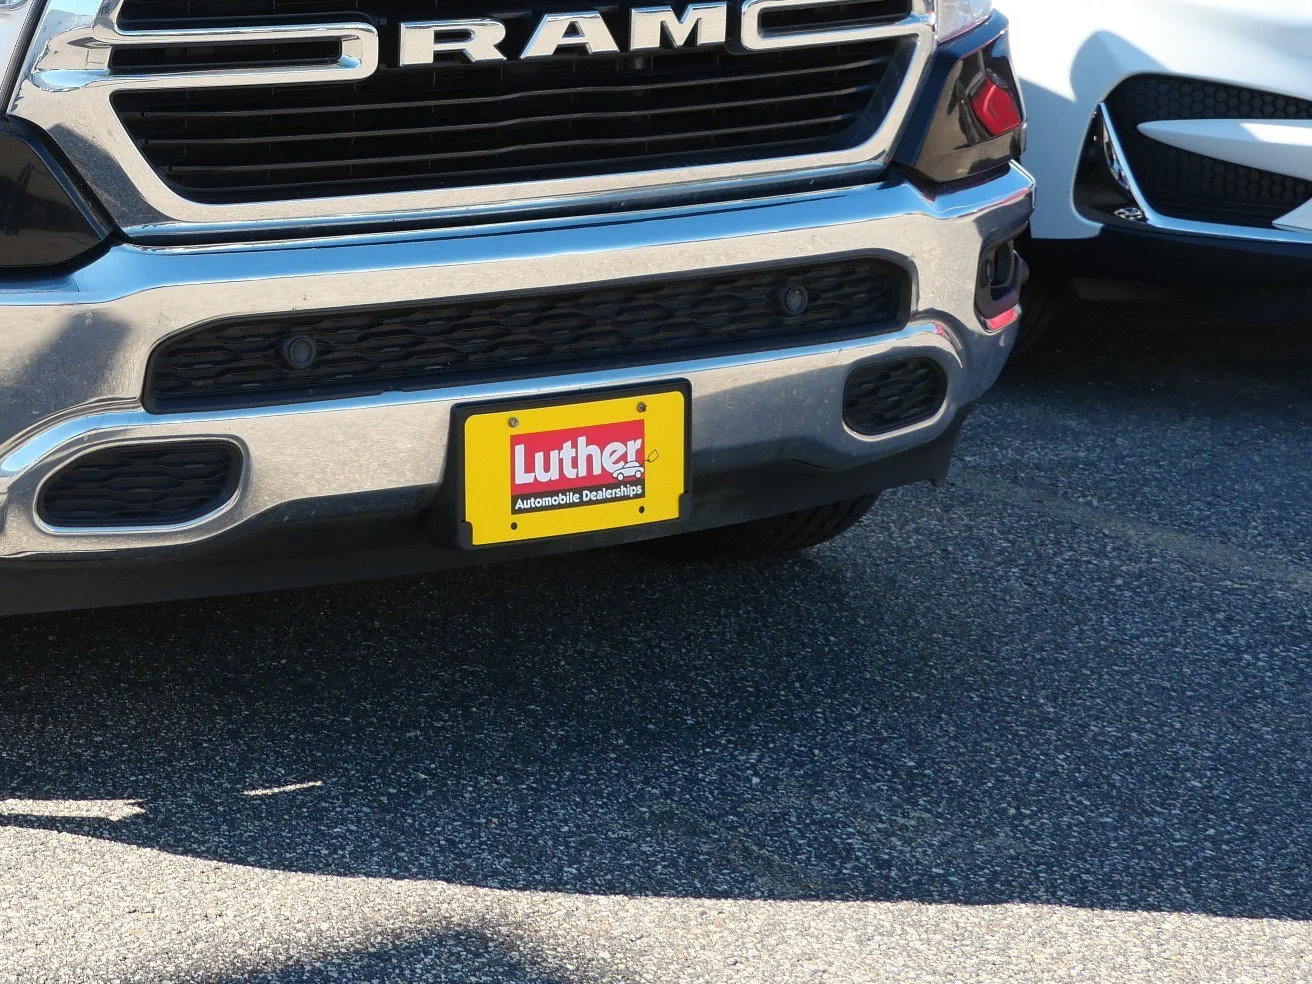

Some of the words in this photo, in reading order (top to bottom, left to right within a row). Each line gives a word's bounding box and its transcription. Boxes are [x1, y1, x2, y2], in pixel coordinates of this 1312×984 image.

[399, 1, 728, 67] RAM
[514, 435, 643, 485] Luther
[514, 490, 581, 510] Automobile
[582, 483, 643, 503] Dealerships
